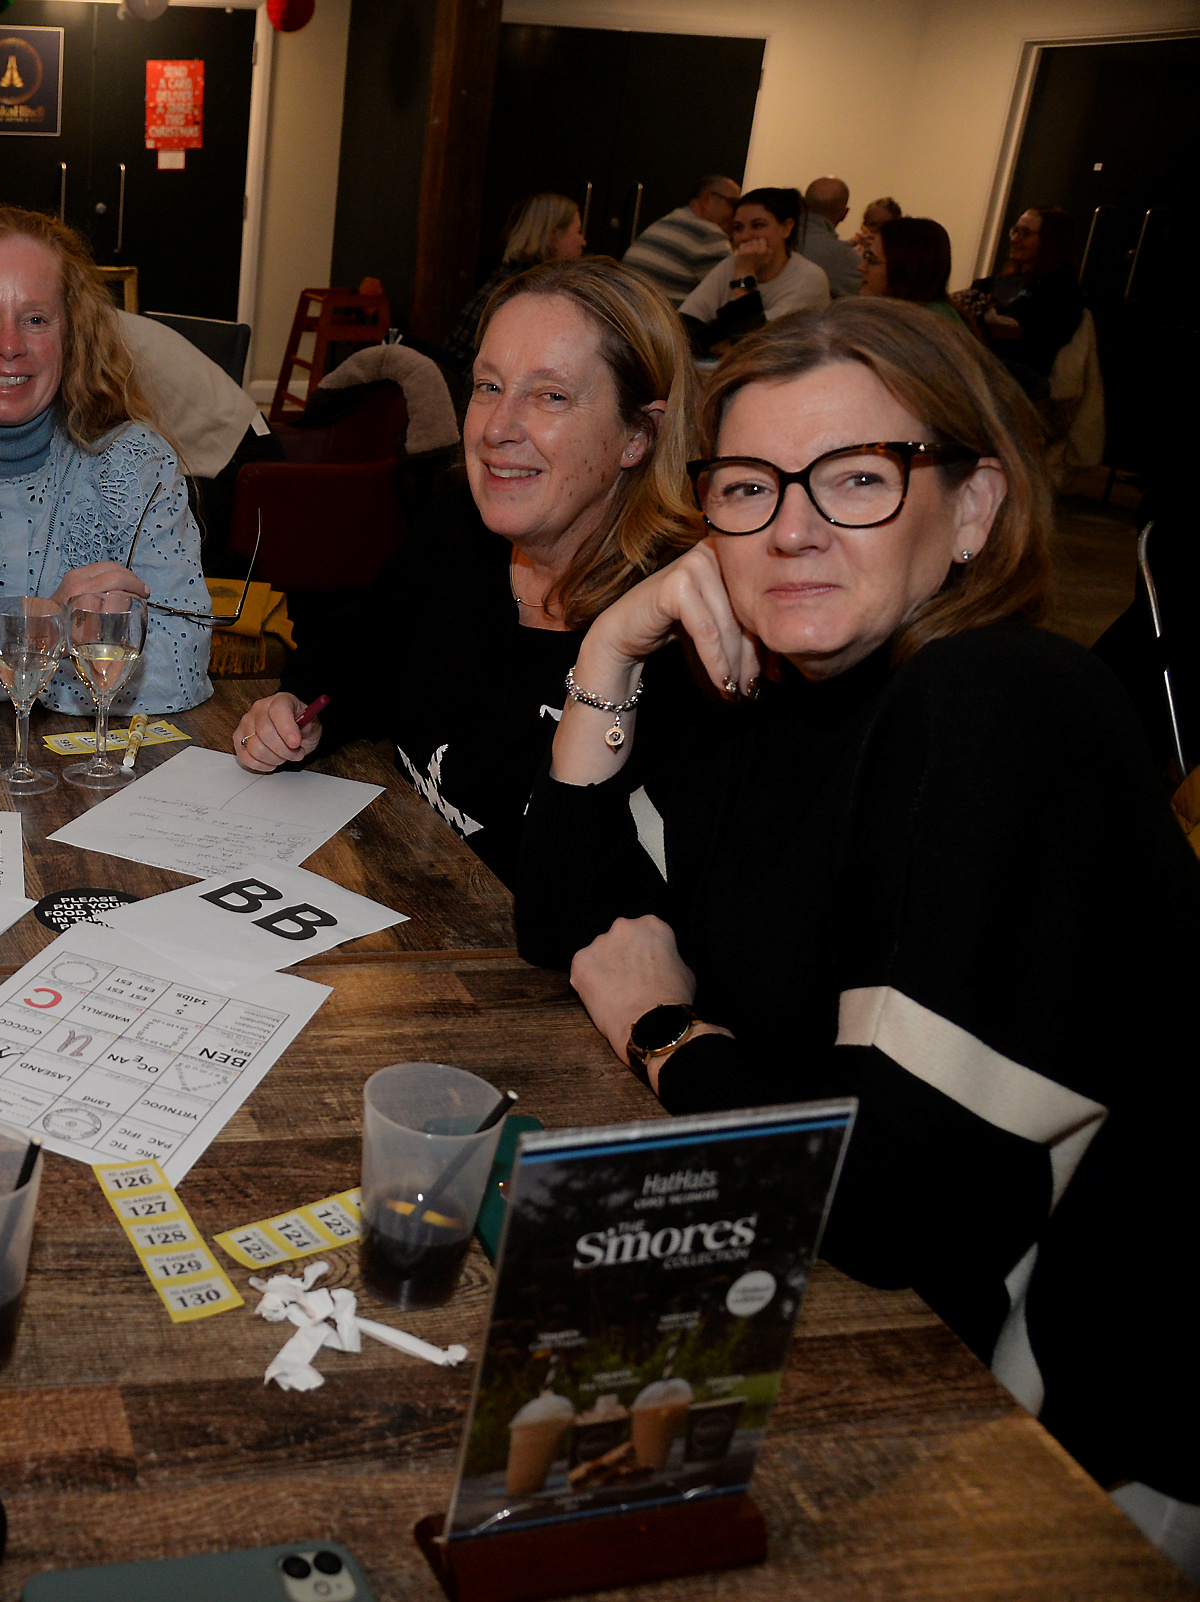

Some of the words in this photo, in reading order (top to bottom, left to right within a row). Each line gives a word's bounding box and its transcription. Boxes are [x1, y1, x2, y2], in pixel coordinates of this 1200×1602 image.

[59, 738, 79, 751] 136
[52, 902, 84, 911] PUT
[59, 895, 119, 904] PLEASE
[44, 909, 87, 918] FOOD
[51, 916, 65, 924] IN
[105, 985, 125, 995] EST
[129, 992, 148, 1002] EST
[114, 977, 133, 986] EST
[137, 984, 157, 994] EST
[23, 987, 63, 1009] C
[176, 992, 209, 1006] 14lbs
[198, 1047, 248, 1068] BEN
[230, 1047, 252, 1057] Ben
[19, 1061, 73, 1082] LASEAND
[81, 1094, 112, 1108] Land
[140, 1098, 199, 1121] YRTNUOC
[117, 1127, 142, 1140] IFIC
[108, 1140, 128, 1151] TIC
[147, 1137, 173, 1149] PAC
[134, 1147, 162, 1160] ARC
[111, 1173, 154, 1189] 126
[128, 1200, 168, 1217] 127
[318, 1208, 352, 1237] 123
[144, 1230, 188, 1246] 128
[277, 1222, 312, 1248] 124
[237, 1233, 272, 1261] 125
[158, 1259, 203, 1277] 129
[176, 1288, 221, 1308] 130
